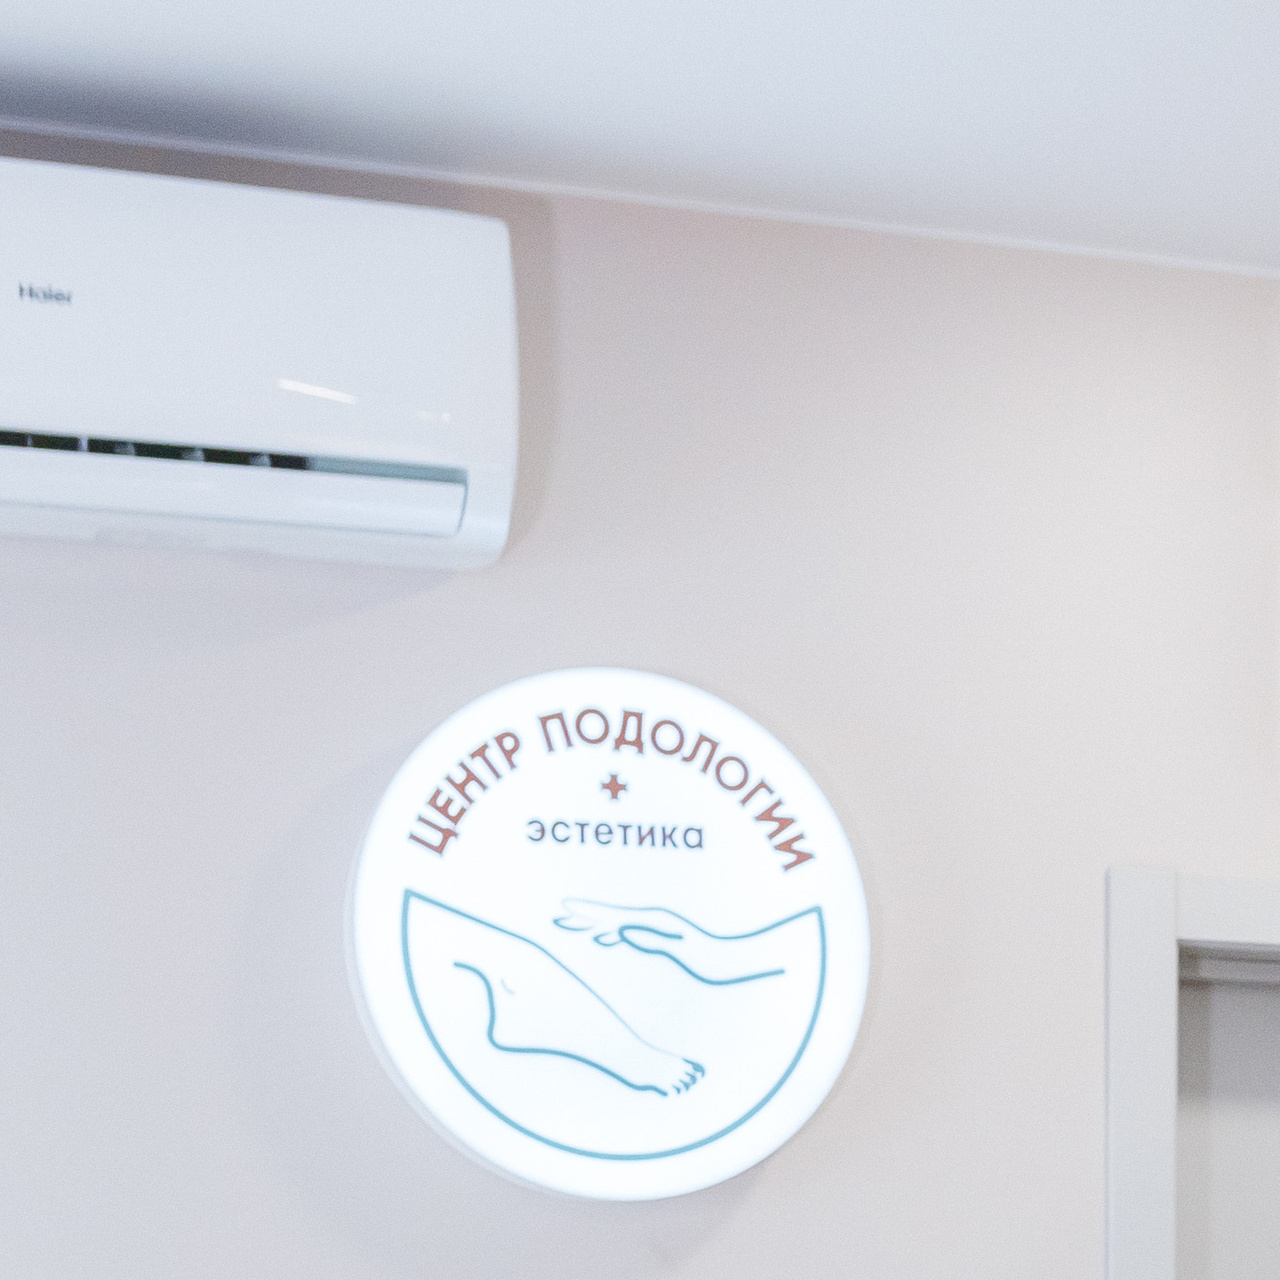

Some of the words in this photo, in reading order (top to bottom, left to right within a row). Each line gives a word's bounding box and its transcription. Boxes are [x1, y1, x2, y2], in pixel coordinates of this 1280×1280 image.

[408, 731, 521, 856] ЦЕНТР
[539, 708, 816, 872] ПОДОЛОГИИ
[527, 819, 704, 849] эстетика
